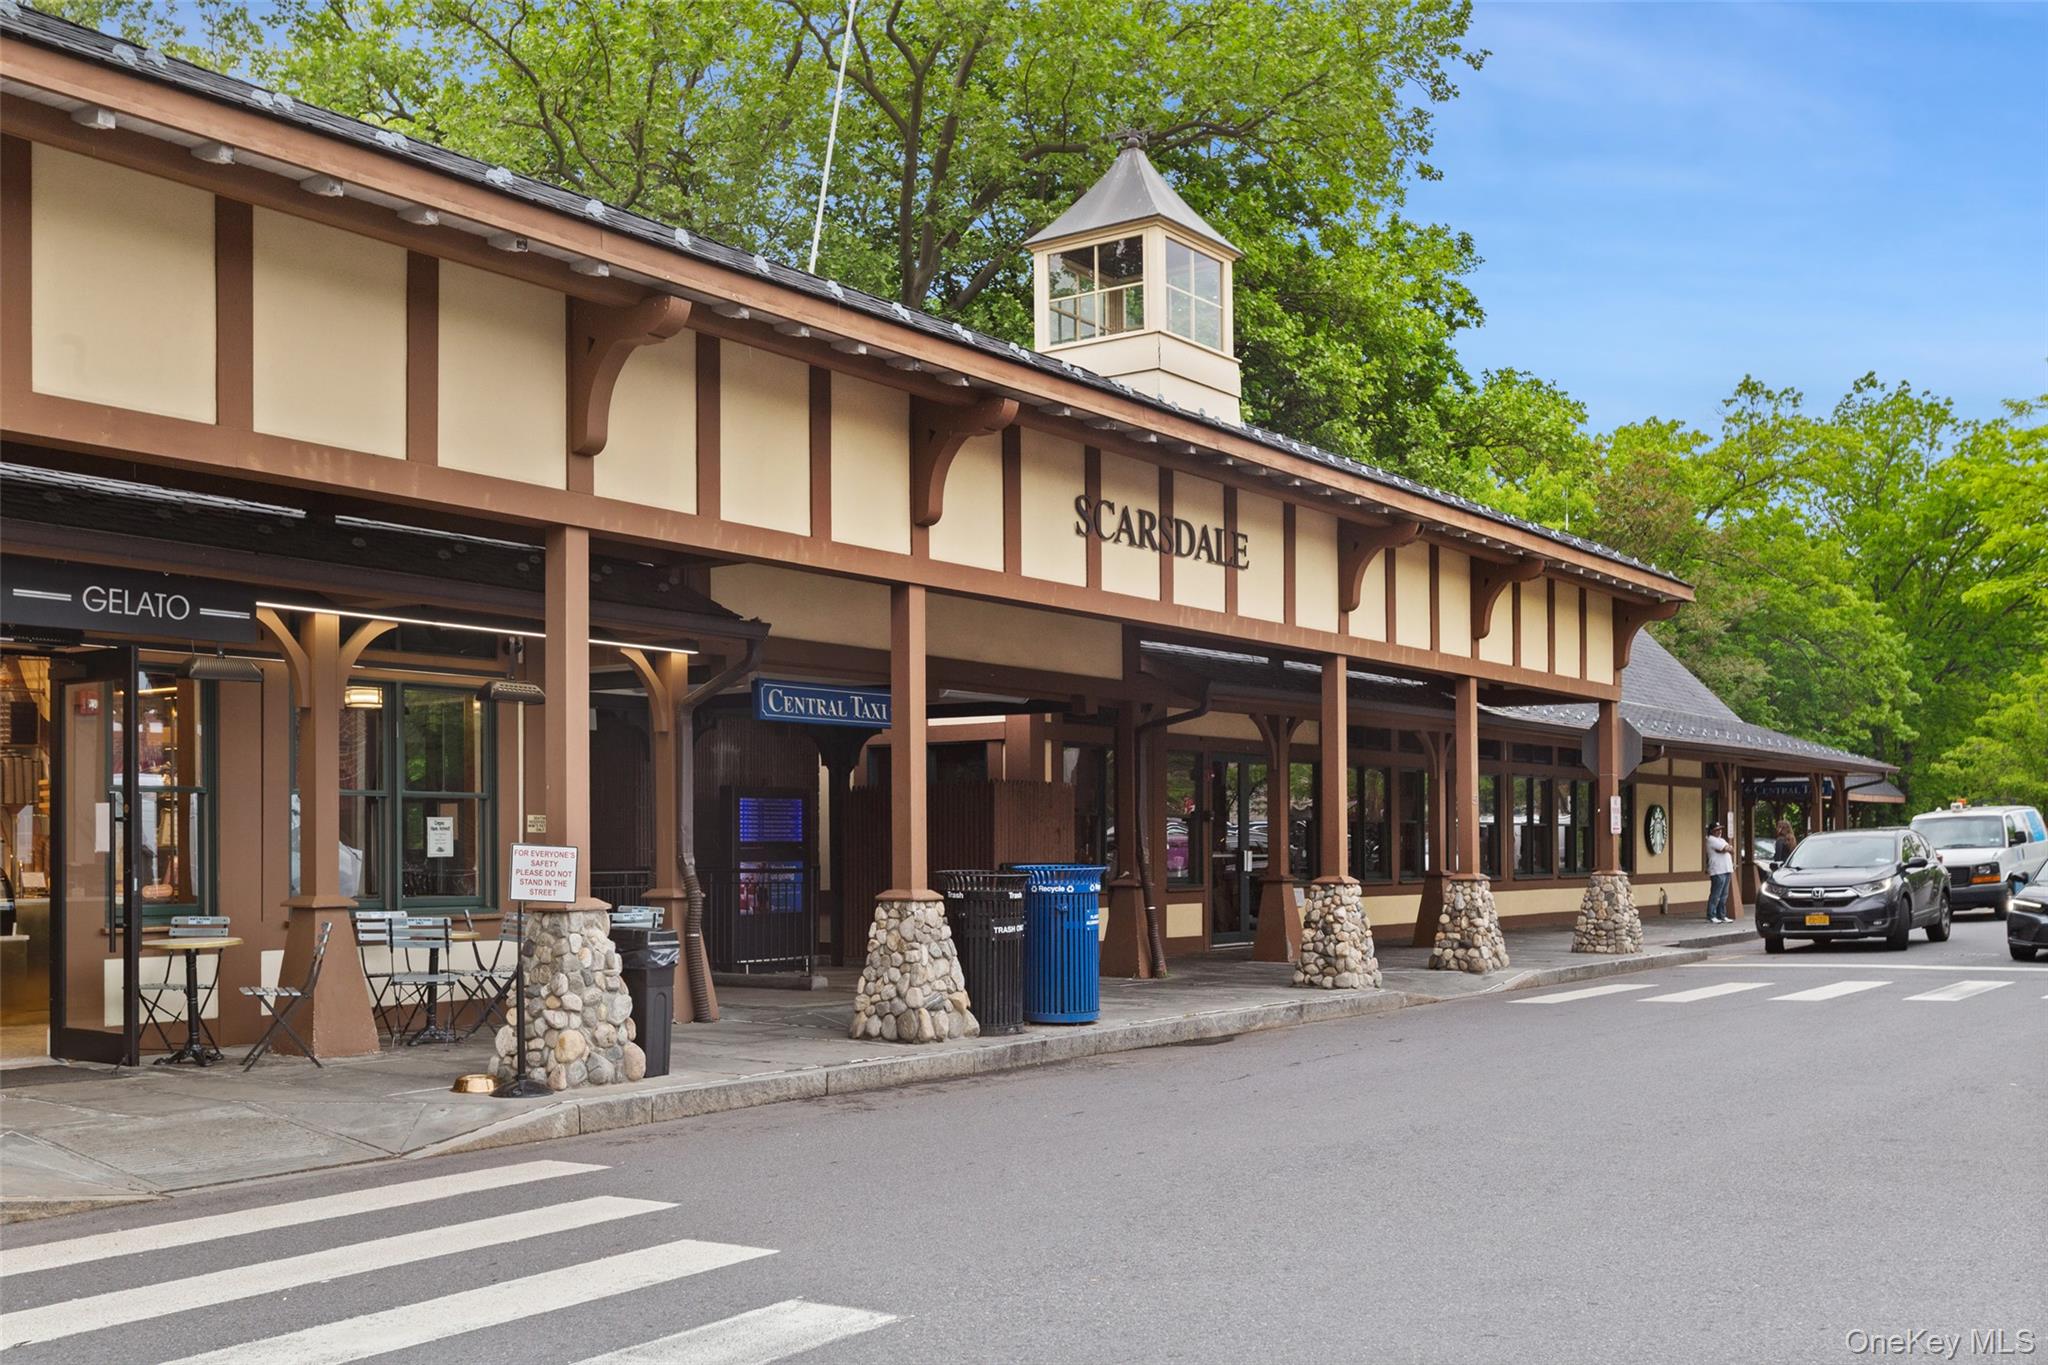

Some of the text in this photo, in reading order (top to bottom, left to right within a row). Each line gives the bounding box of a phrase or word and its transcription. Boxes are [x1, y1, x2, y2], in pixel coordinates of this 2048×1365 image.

[1074, 494, 1250, 570] SCARSDALE
[82, 585, 190, 620] GELATO
[768, 688, 888, 720] CENTRAL TAXI
[514, 849, 576, 858] FOR EVERYONE'S
[530, 860, 559, 868] SAFETY
[515, 868, 543, 877] PLEASE
[557, 870, 573, 878] NOT
[529, 888, 557, 896] STREET
[1038, 885, 1066, 894] Recycle
[947, 891, 964, 899] Trash
[993, 925, 1015, 934] TRASH
